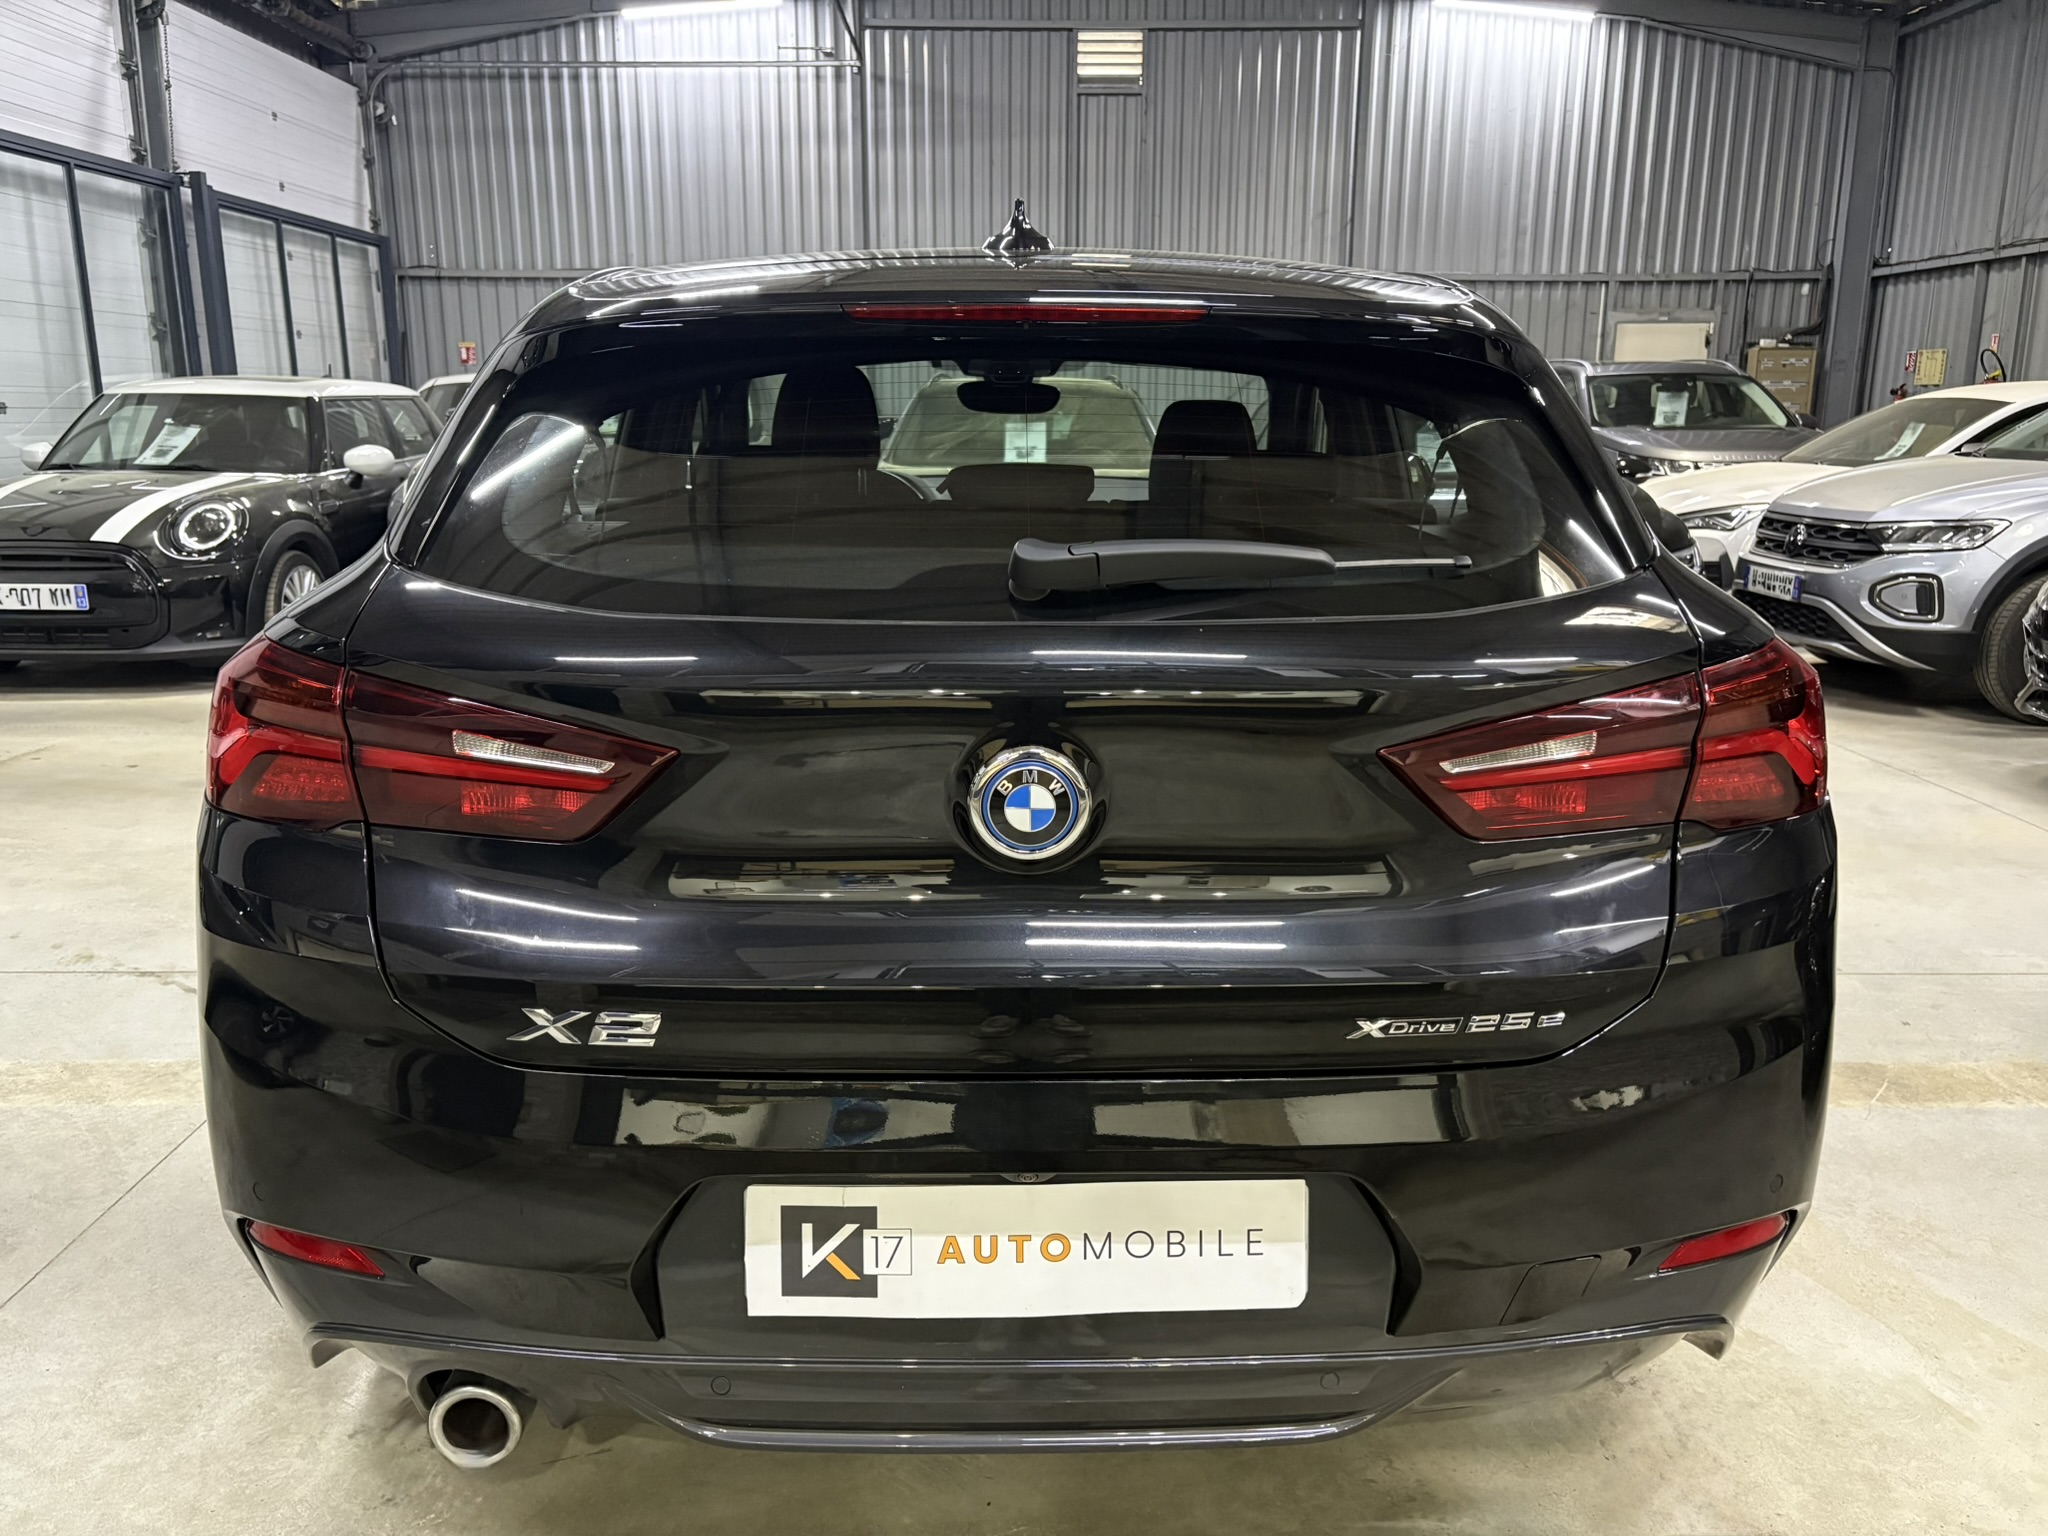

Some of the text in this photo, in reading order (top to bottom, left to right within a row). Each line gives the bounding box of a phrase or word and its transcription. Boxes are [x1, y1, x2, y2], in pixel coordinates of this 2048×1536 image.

[997, 770, 1065, 796] BMW
[506, 1008, 662, 1047] X2
[937, 1228, 1264, 1264] AUTOMOBILE
